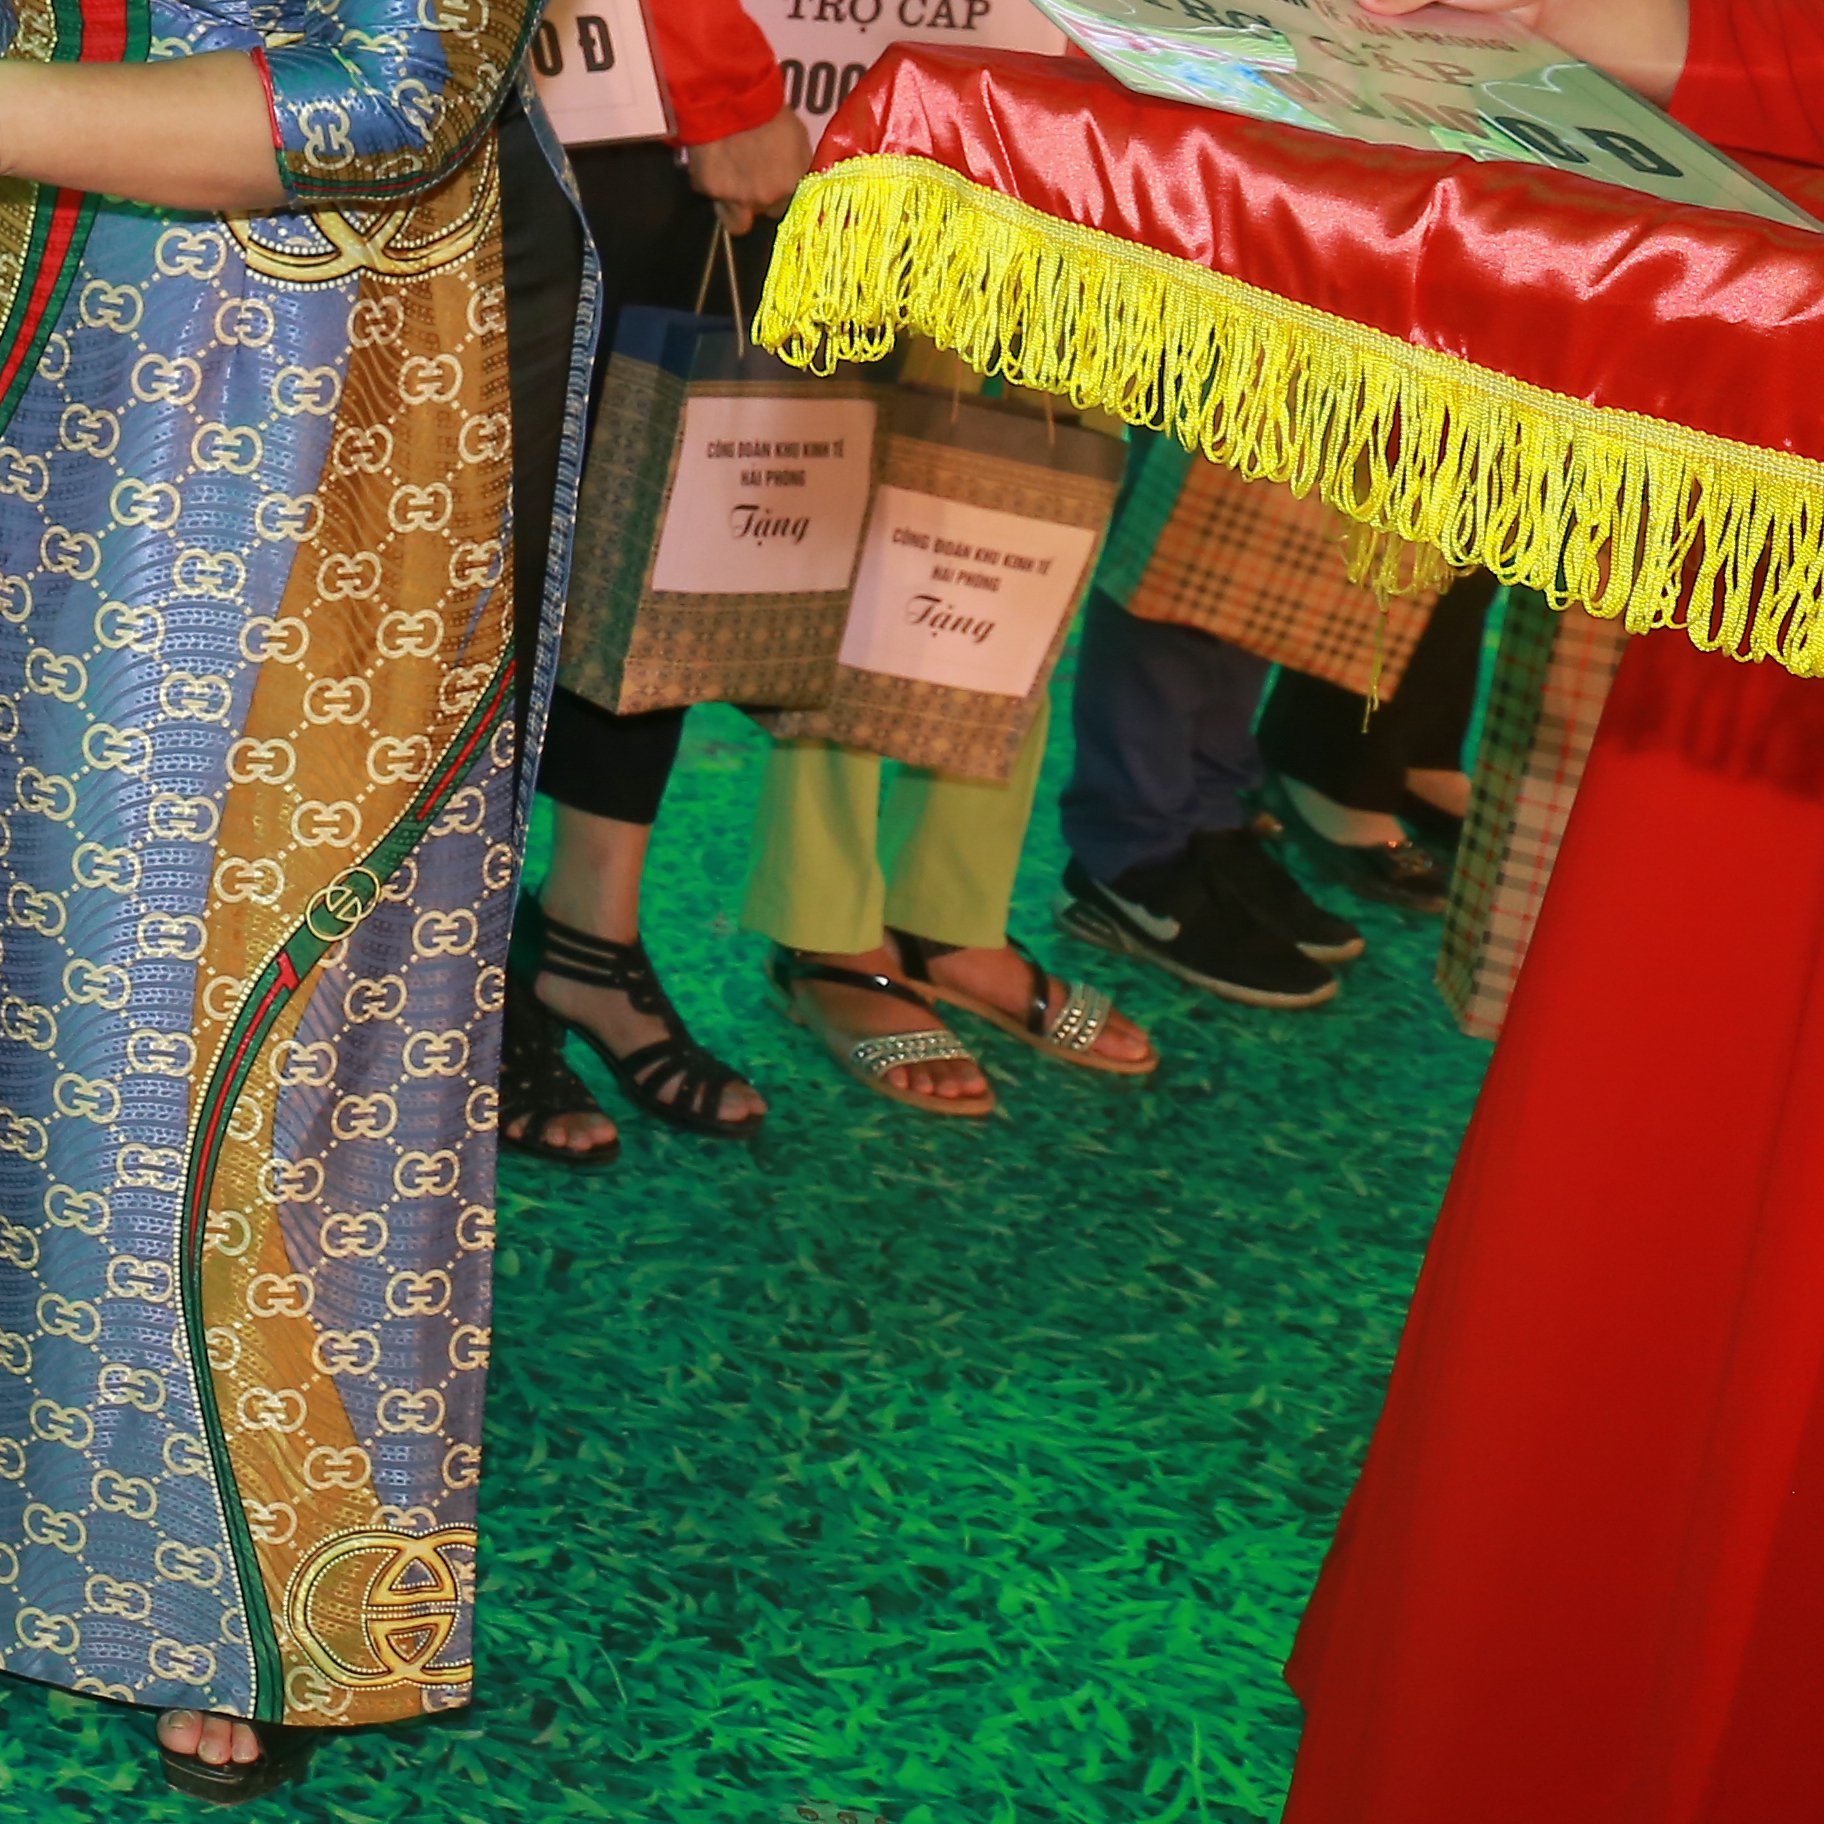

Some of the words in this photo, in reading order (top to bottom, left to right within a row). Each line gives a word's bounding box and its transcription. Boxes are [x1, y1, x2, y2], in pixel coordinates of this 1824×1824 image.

[576, 15, 615, 72] Đ
[1575, 127, 1684, 177] Đ
[730, 504, 811, 547] Tặng
[906, 594, 996, 644] Tặng
